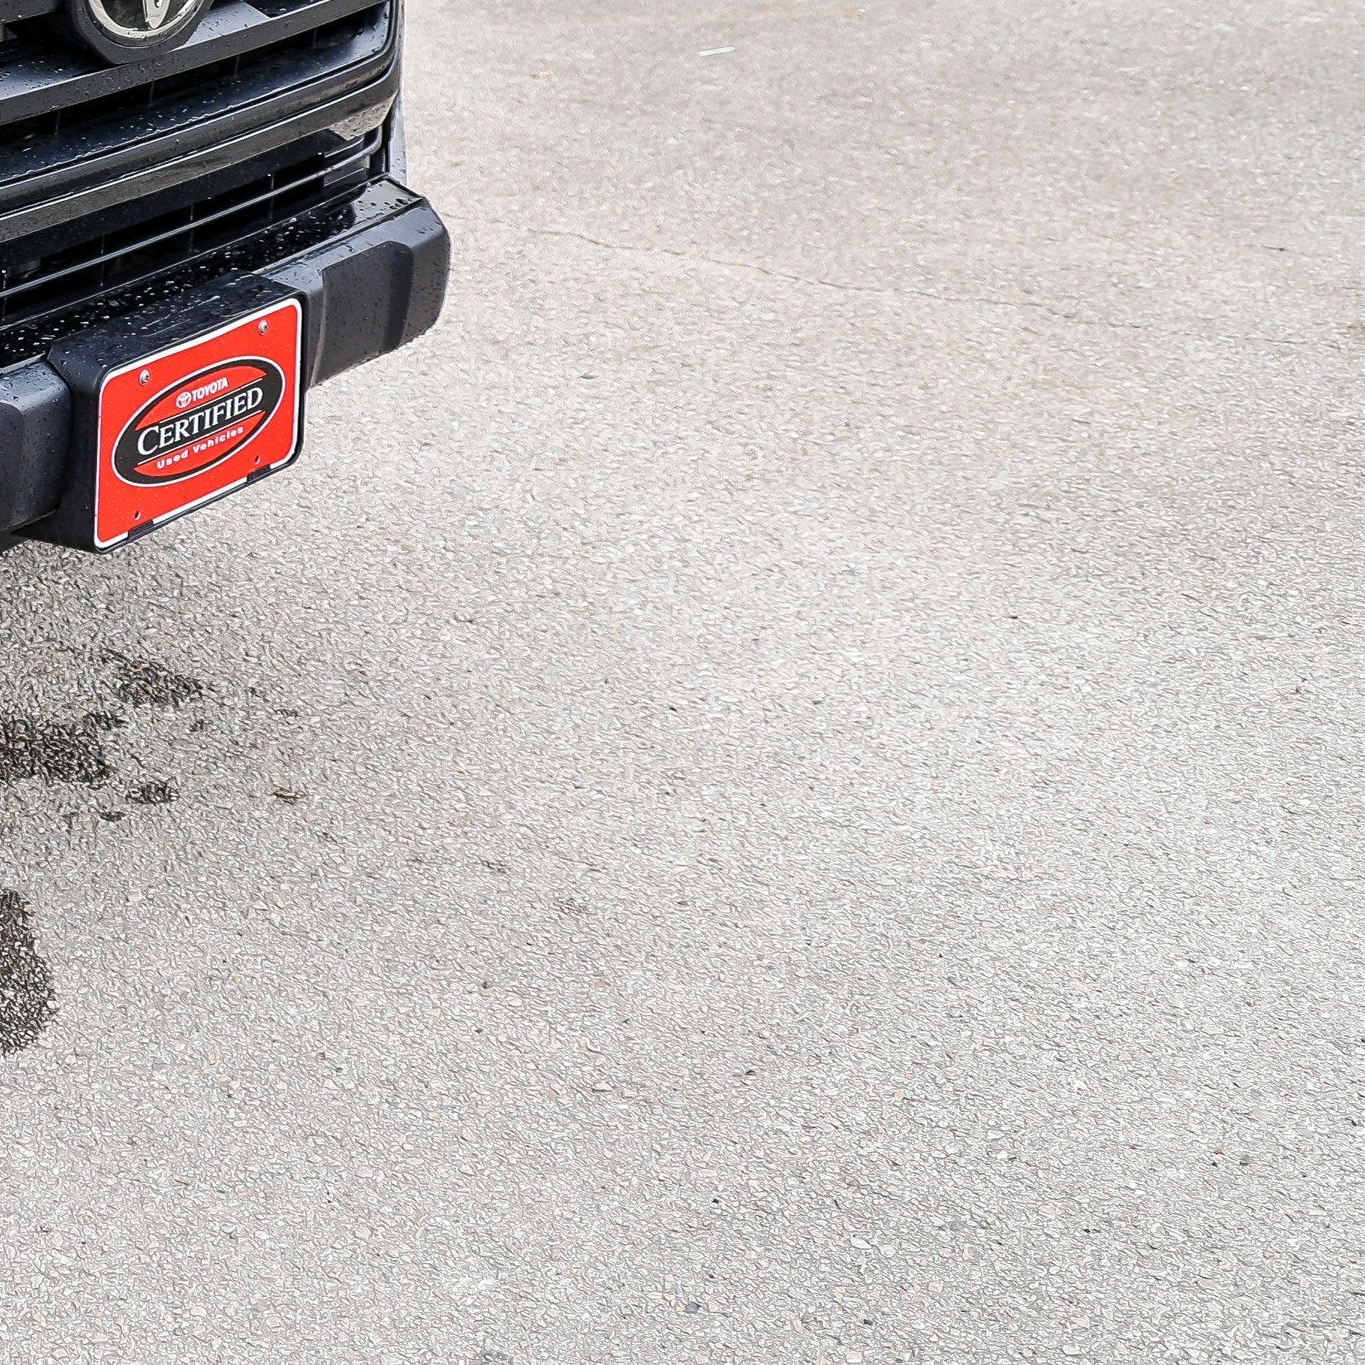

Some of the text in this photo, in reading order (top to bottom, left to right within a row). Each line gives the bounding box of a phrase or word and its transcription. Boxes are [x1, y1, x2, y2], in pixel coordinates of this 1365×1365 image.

[192, 377, 228, 400] TOYOTA
[137, 387, 263, 456] CERTIFIED
[157, 427, 244, 469] Used Vehicles
